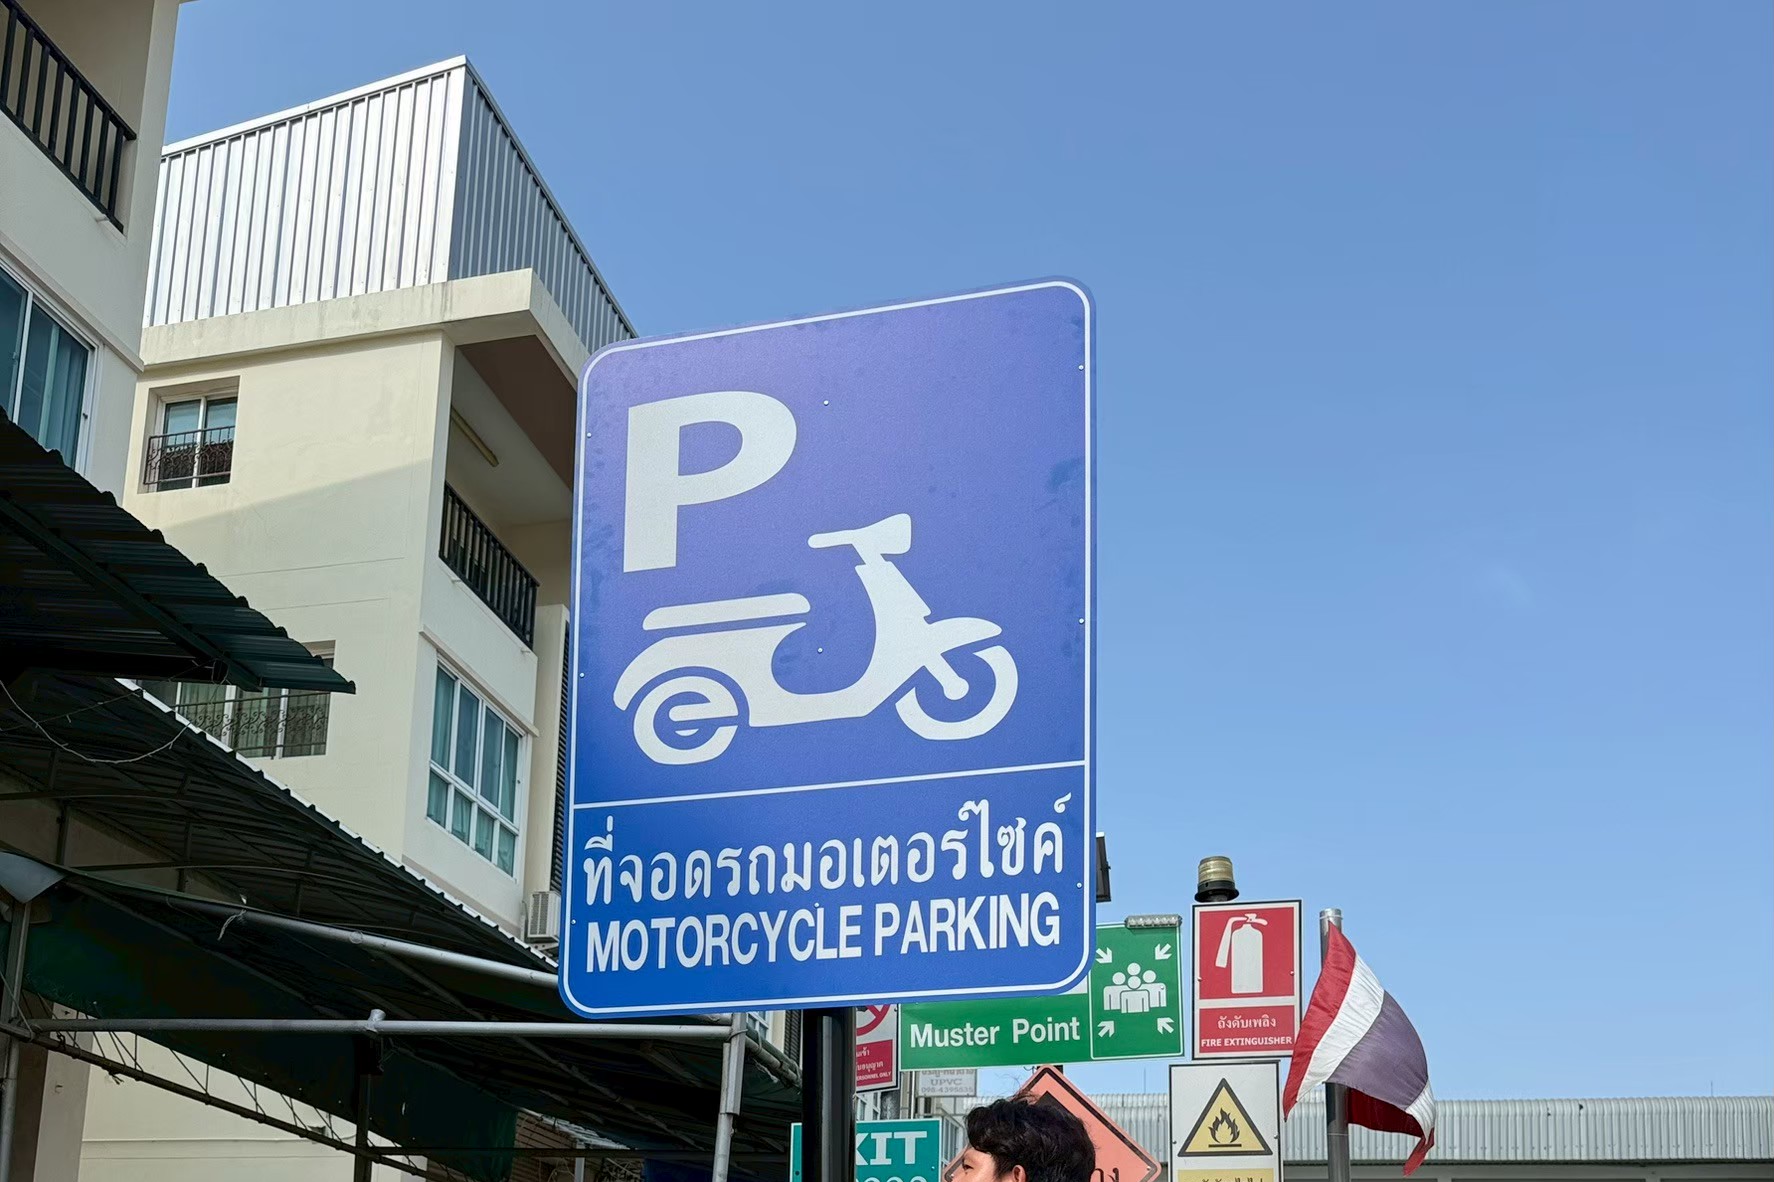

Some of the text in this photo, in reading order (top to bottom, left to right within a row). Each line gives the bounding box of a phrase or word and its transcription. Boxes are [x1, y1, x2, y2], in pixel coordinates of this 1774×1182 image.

[624, 391, 797, 572] P
[585, 891, 1061, 973] MOTORCYCLE PARKING
[910, 1016, 1081, 1048] Muster Point
[1217, 1013, 1277, 1030] ถังดับเพลิง
[1201, 1036, 1293, 1047] FIRE EXTINGUISHER
[930, 1078, 963, 1086] UPVC
